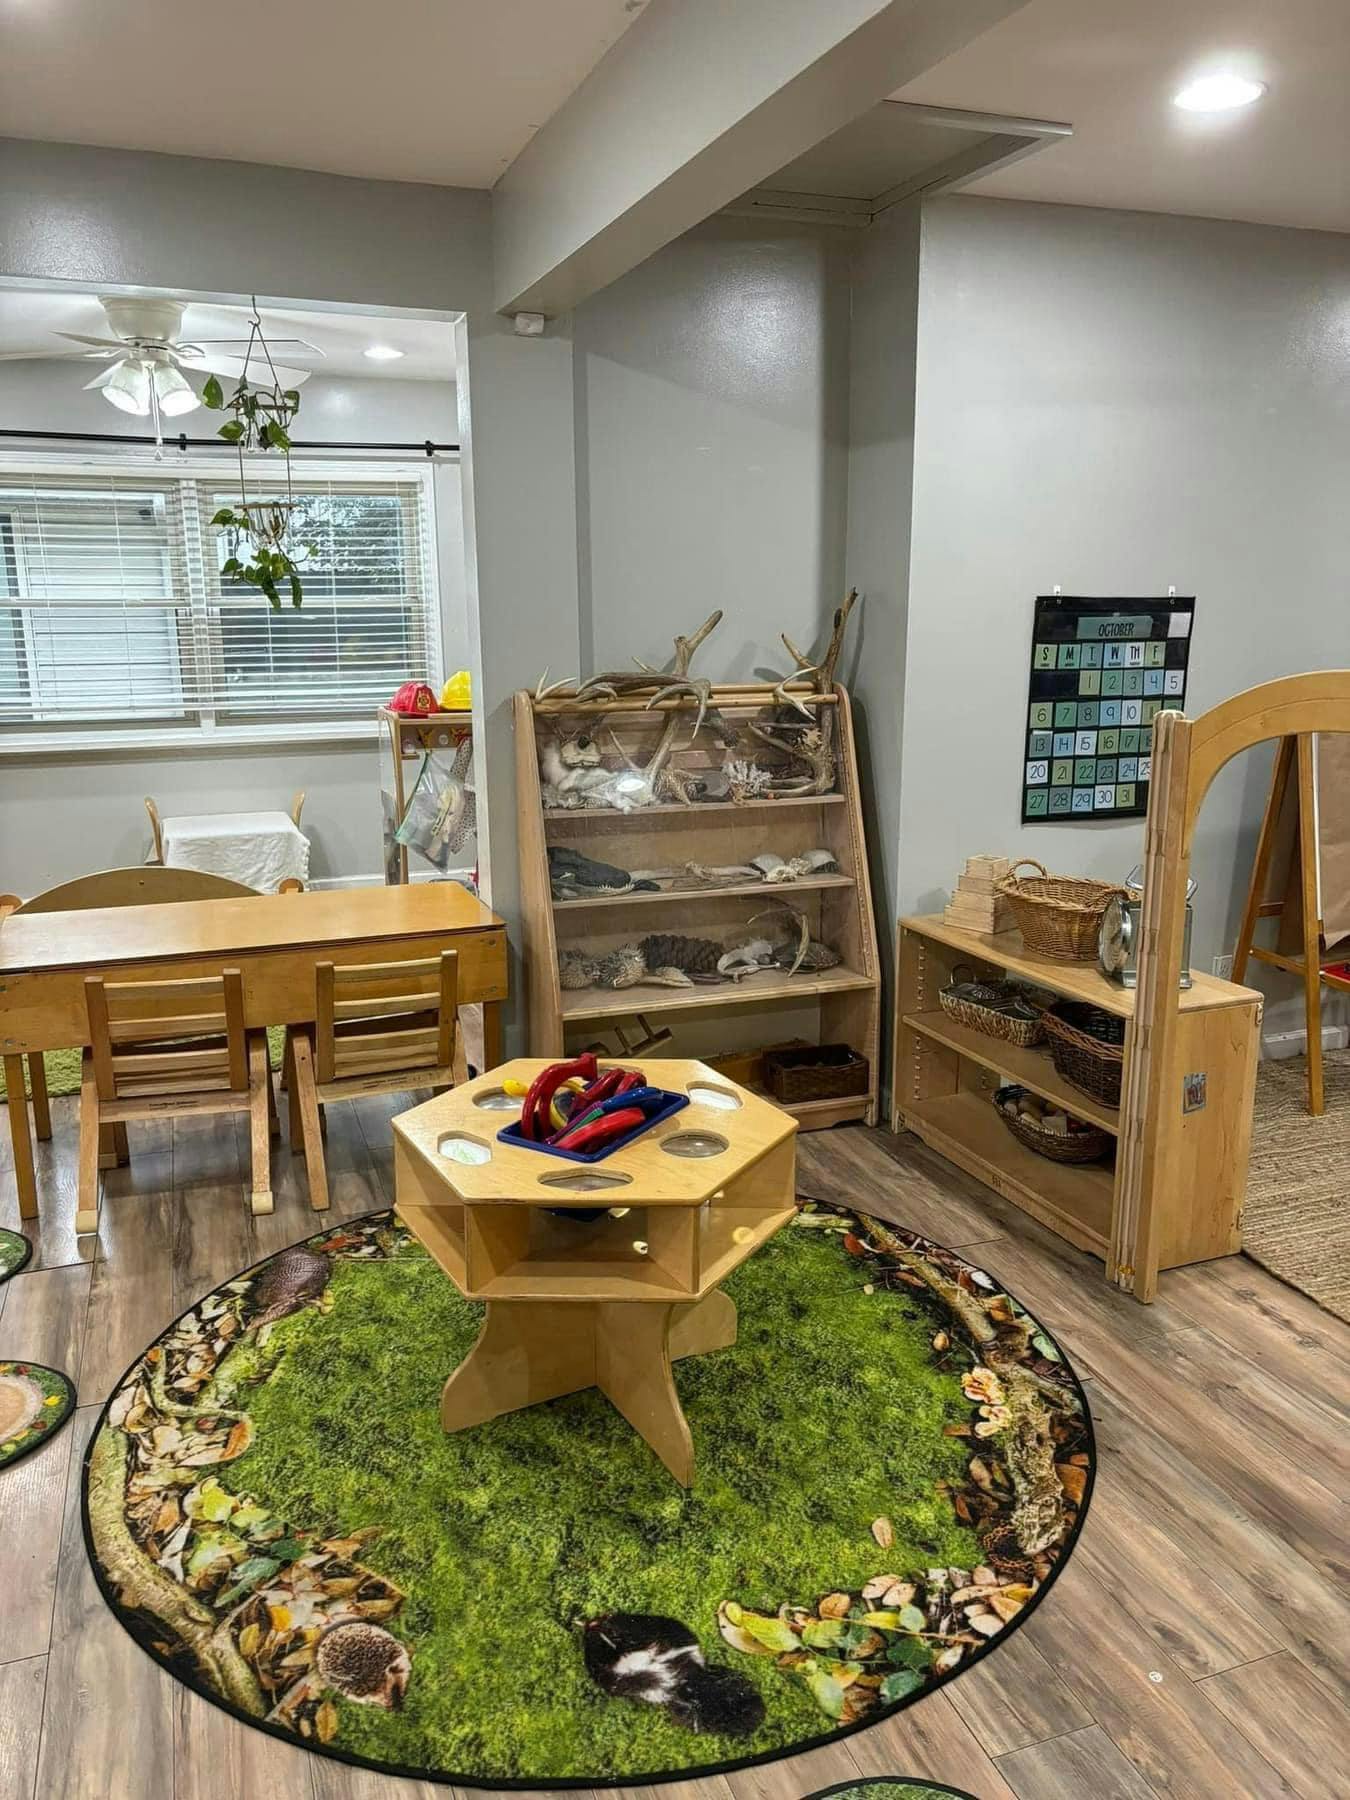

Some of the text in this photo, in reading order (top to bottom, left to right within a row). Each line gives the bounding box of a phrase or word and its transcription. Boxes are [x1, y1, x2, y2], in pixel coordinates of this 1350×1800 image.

[1098, 623, 1134, 637] OCTOBER
[1043, 646, 1159, 661] S M T W TH F
[1087, 676, 1178, 689] 1 2 3 4 5
[1037, 708, 1047, 722] 6
[1062, 707, 1070, 721] 7
[1084, 707, 1092, 721] 8
[1106, 707, 1114, 720] 9
[1127, 706, 1137, 720] 10
[1035, 738, 1045, 751] 13
[1059, 738, 1069, 750] 14
[1080, 737, 1091, 750] 15
[1103, 736, 1113, 749] 16
[1124, 736, 1134, 748] 17
[1031, 765, 1046, 779] 20
[1057, 766, 1067, 779] 21
[1079, 766, 1093, 779] 22
[1101, 766, 1114, 778] 23
[1122, 763, 1137, 777] 24
[1030, 789, 1130, 808] 27 28 29 30 31
